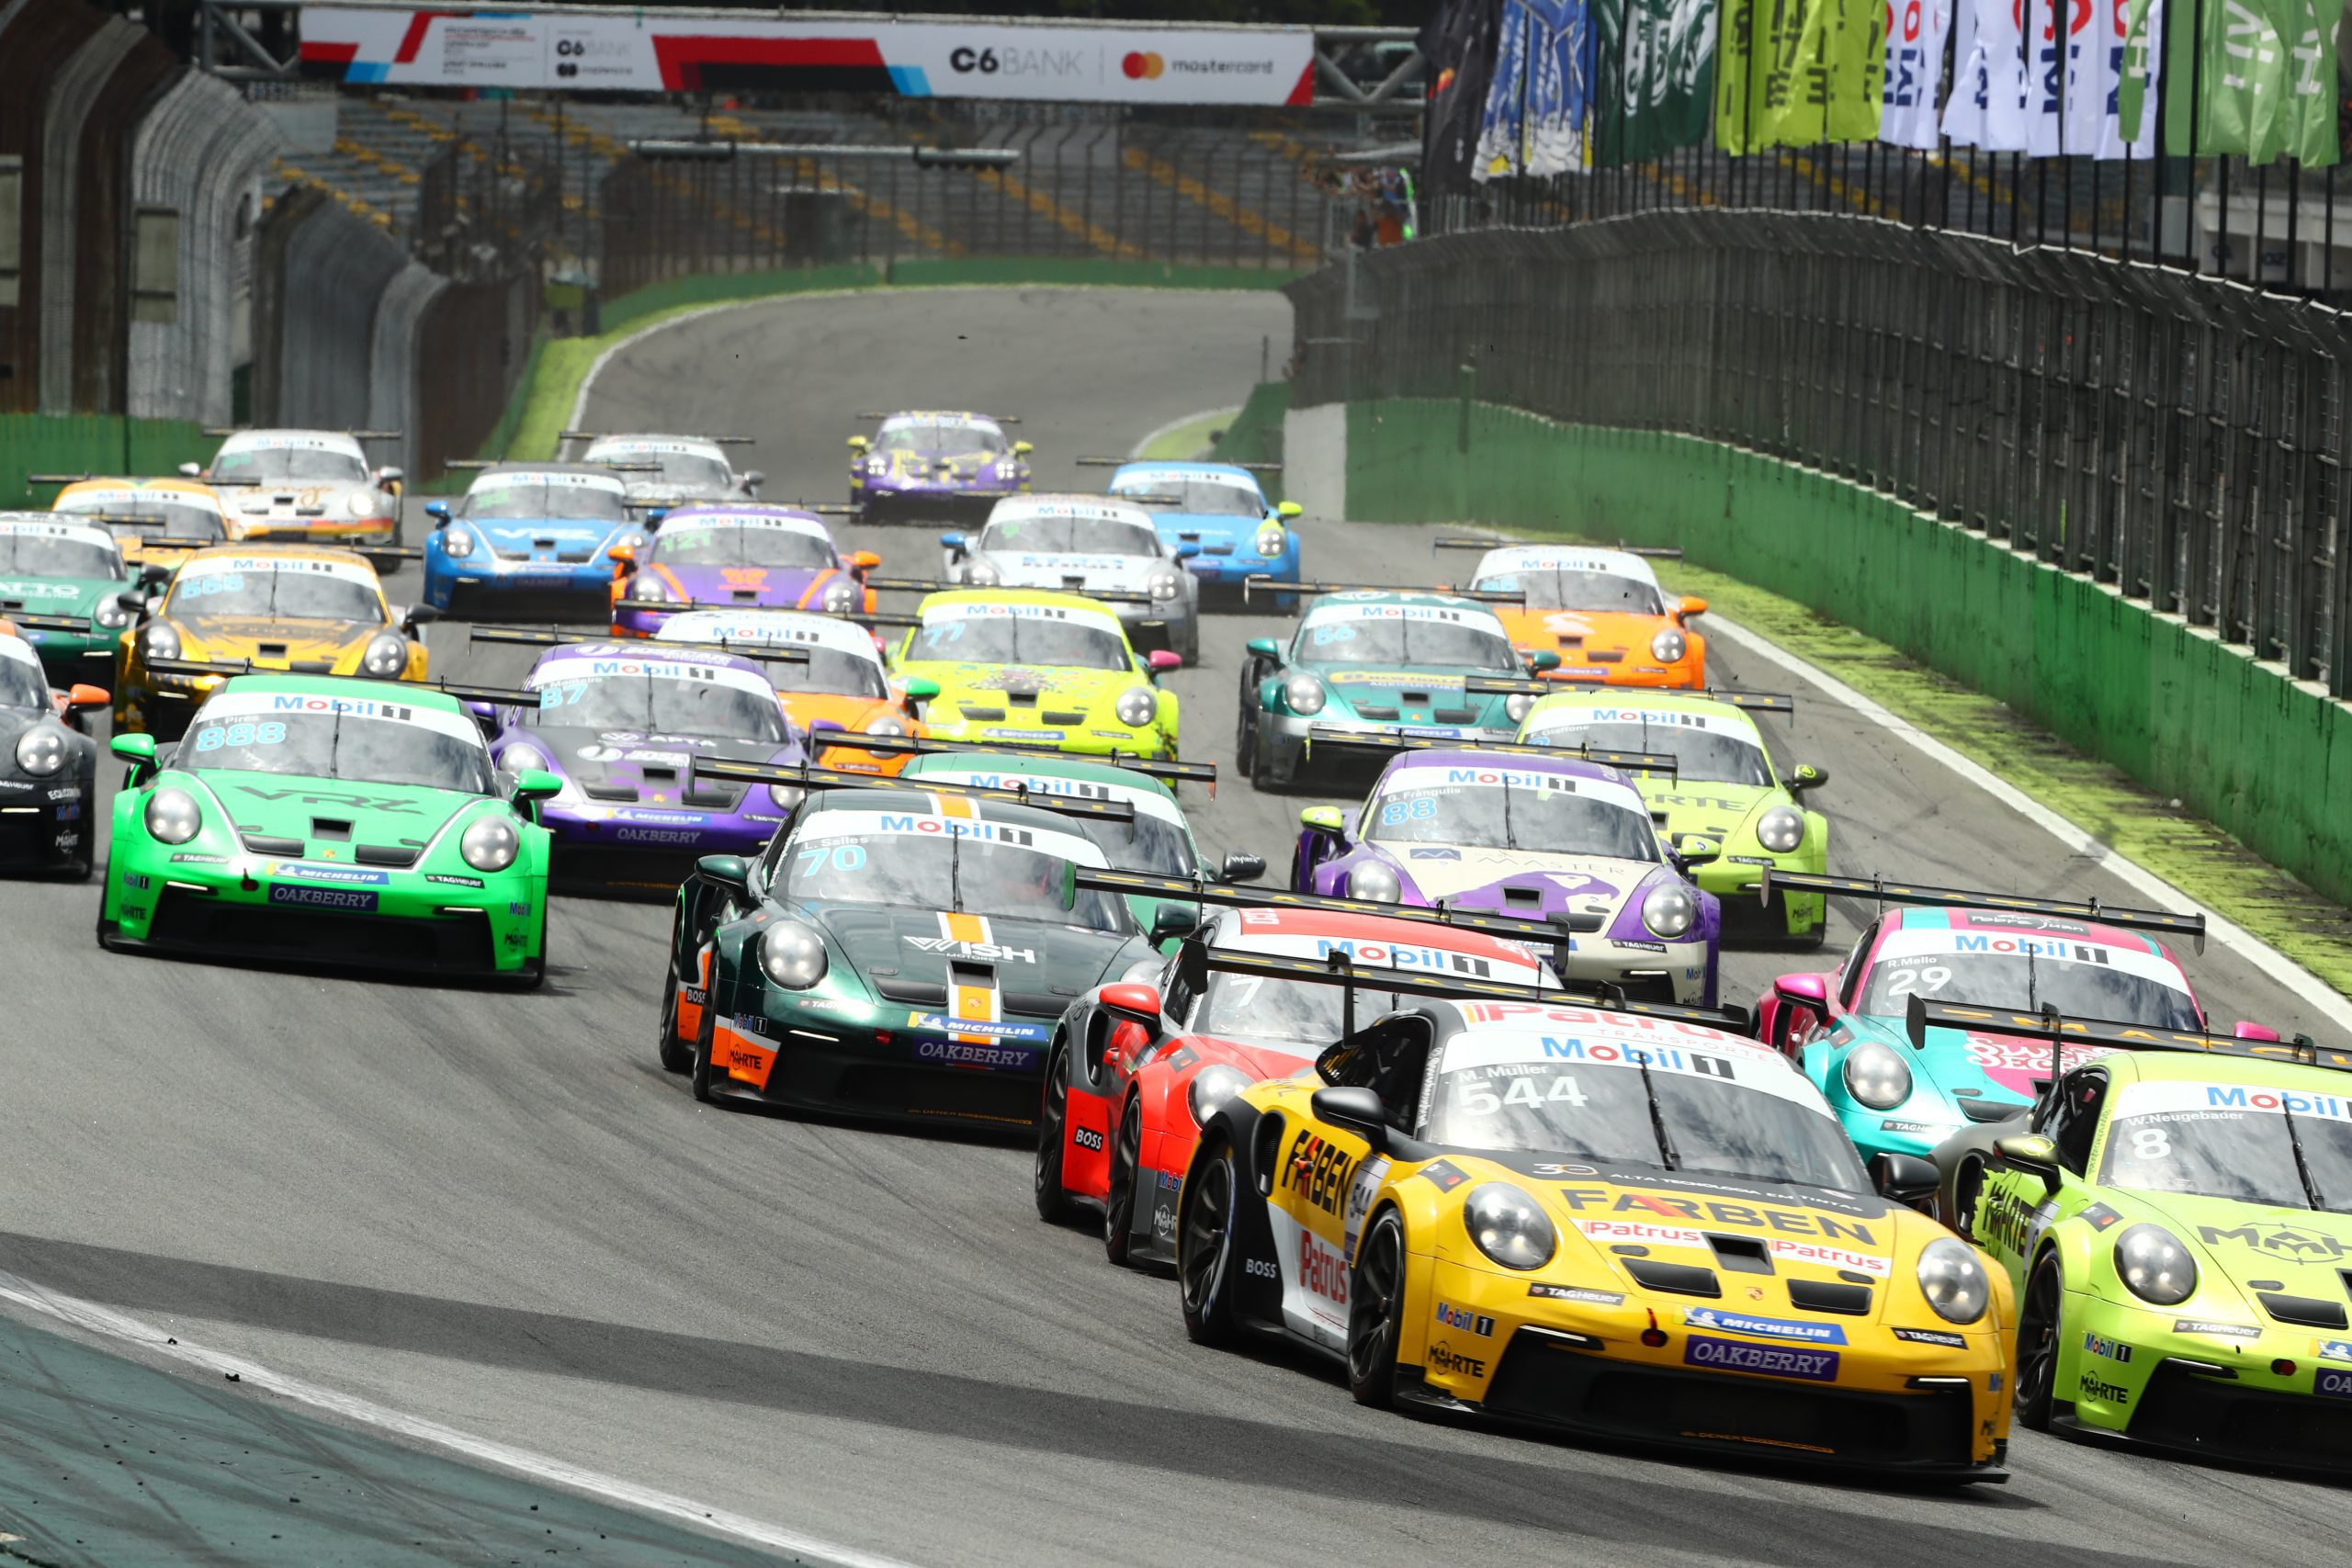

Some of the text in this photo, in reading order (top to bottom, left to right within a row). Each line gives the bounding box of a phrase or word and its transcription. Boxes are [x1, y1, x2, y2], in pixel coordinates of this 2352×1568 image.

[950, 46, 1085, 77] C6 BANK
[1172, 58, 1273, 75] mastercard
[233, 558, 304, 570] Mobil
[967, 604, 1039, 616] Mobil
[1362, 606, 1432, 618] Mobil
[713, 626, 791, 639] Mobil
[923, 621, 967, 647] 77
[593, 661, 679, 676] Mobil
[275, 694, 374, 716] Mobil
[1592, 709, 1676, 724] Mobil
[195, 721, 287, 752] 888
[970, 775, 1071, 795] Mobil
[1448, 769, 1542, 788] Mobil
[1403, 785, 1462, 800] Frangulis
[1382, 796, 1438, 827] 88
[617, 828, 701, 844] OAKBERRY
[880, 815, 992, 840] Mobil
[821, 835, 869, 847] Salles
[797, 844, 867, 878] 70
[299, 868, 380, 882] MICHELIN
[274, 886, 373, 908] OAKBERRY
[902, 935, 1036, 964] WISH
[945, 953, 995, 962] MOTORS
[1317, 940, 1444, 969] Mobil
[1622, 941, 1666, 953] TAGHeuer
[1955, 935, 2066, 957] Mobil
[1229, 976, 1264, 1008] 7
[1887, 965, 1952, 997] 29
[946, 1021, 1035, 1036] MICHELIN
[1486, 1003, 1777, 1055] Patrus
[919, 1042, 1030, 1066] OAKBERRY
[1541, 1036, 1684, 1070] Mobil
[1597, 1029, 1785, 1067] TRANSPORTES
[1457, 1070, 1483, 1083] M.
[1458, 1076, 1589, 1117] 544
[2206, 1086, 2339, 1117] Mobil
[1075, 1127, 1102, 1151] BOSS
[2132, 1128, 2172, 1160] 8
[1159, 1169, 1184, 1192] Mobi
[1609, 1172, 1864, 1213] ALTA TECNOLOGIA EM TINTAS
[1559, 1188, 1877, 1247] FARBEN
[1588, 1220, 1884, 1271] Patrus Patrus
[1245, 1258, 1277, 1280] BOSS
[1299, 1229, 1348, 1305] Patrus
[1547, 1286, 1623, 1305] TAGHeuer
[1436, 1301, 1474, 1332] Mobil
[1721, 1316, 1832, 1338] MICHELIN
[1907, 1329, 1964, 1348] TAGHeuer
[2191, 1322, 2259, 1337] TAGHeuer
[2084, 1332, 2114, 1359] Mobil
[1693, 1342, 1831, 1377] OAKBERRY
